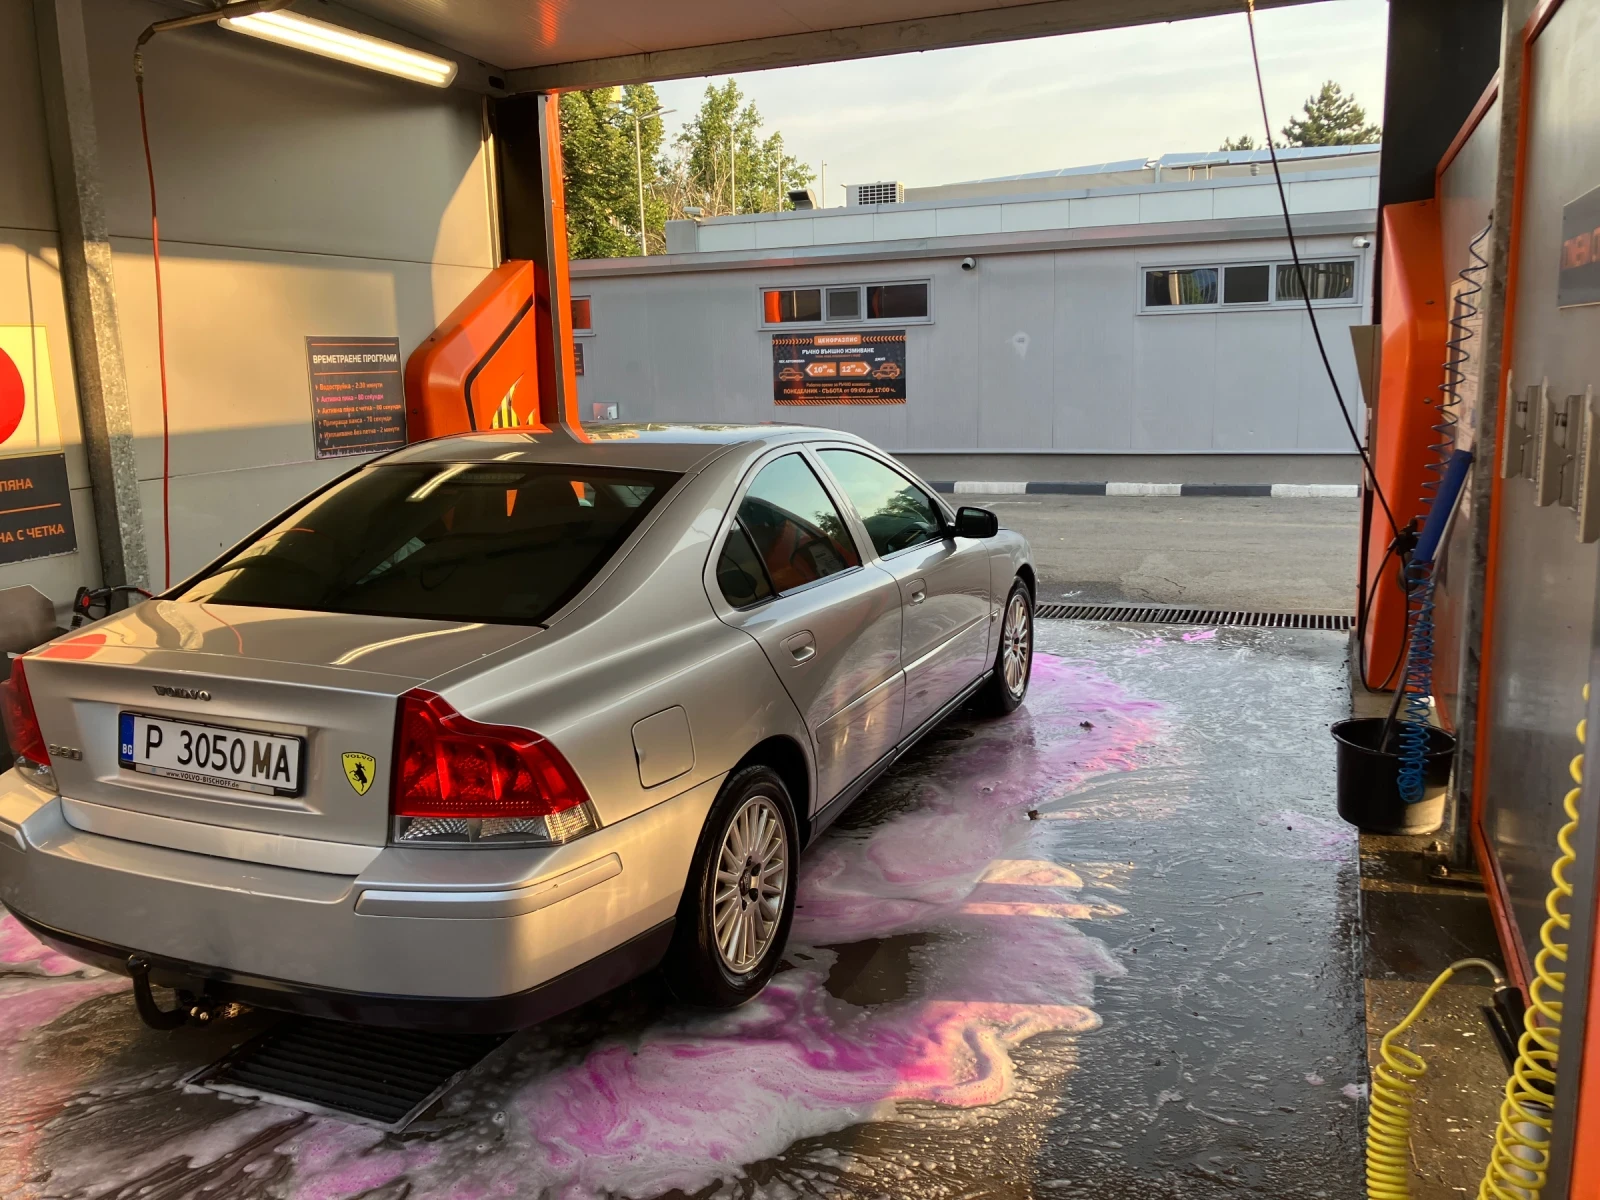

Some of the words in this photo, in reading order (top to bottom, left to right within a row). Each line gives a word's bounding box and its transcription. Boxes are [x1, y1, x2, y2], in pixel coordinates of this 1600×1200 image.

[817, 336, 859, 344] ЦЕНОРАЗПИС
[820, 347, 844, 355] ВЪНШНО
[312, 354, 362, 364] ВРЕМЕТРАЕНЕ
[363, 353, 398, 363] ПРОГРАМИ
[0, 478, 34, 493] ПЯНА
[16, 529, 25, 541] С
[26, 523, 66, 539] ЧЕТКА
[152, 685, 212, 702] VOLVO
[122, 743, 133, 755] BG
[177, 729, 246, 775] 3050
[344, 753, 374, 762] VOLVO
[166, 770, 240, 789] www.VOLVO-BISCHOFF.de
